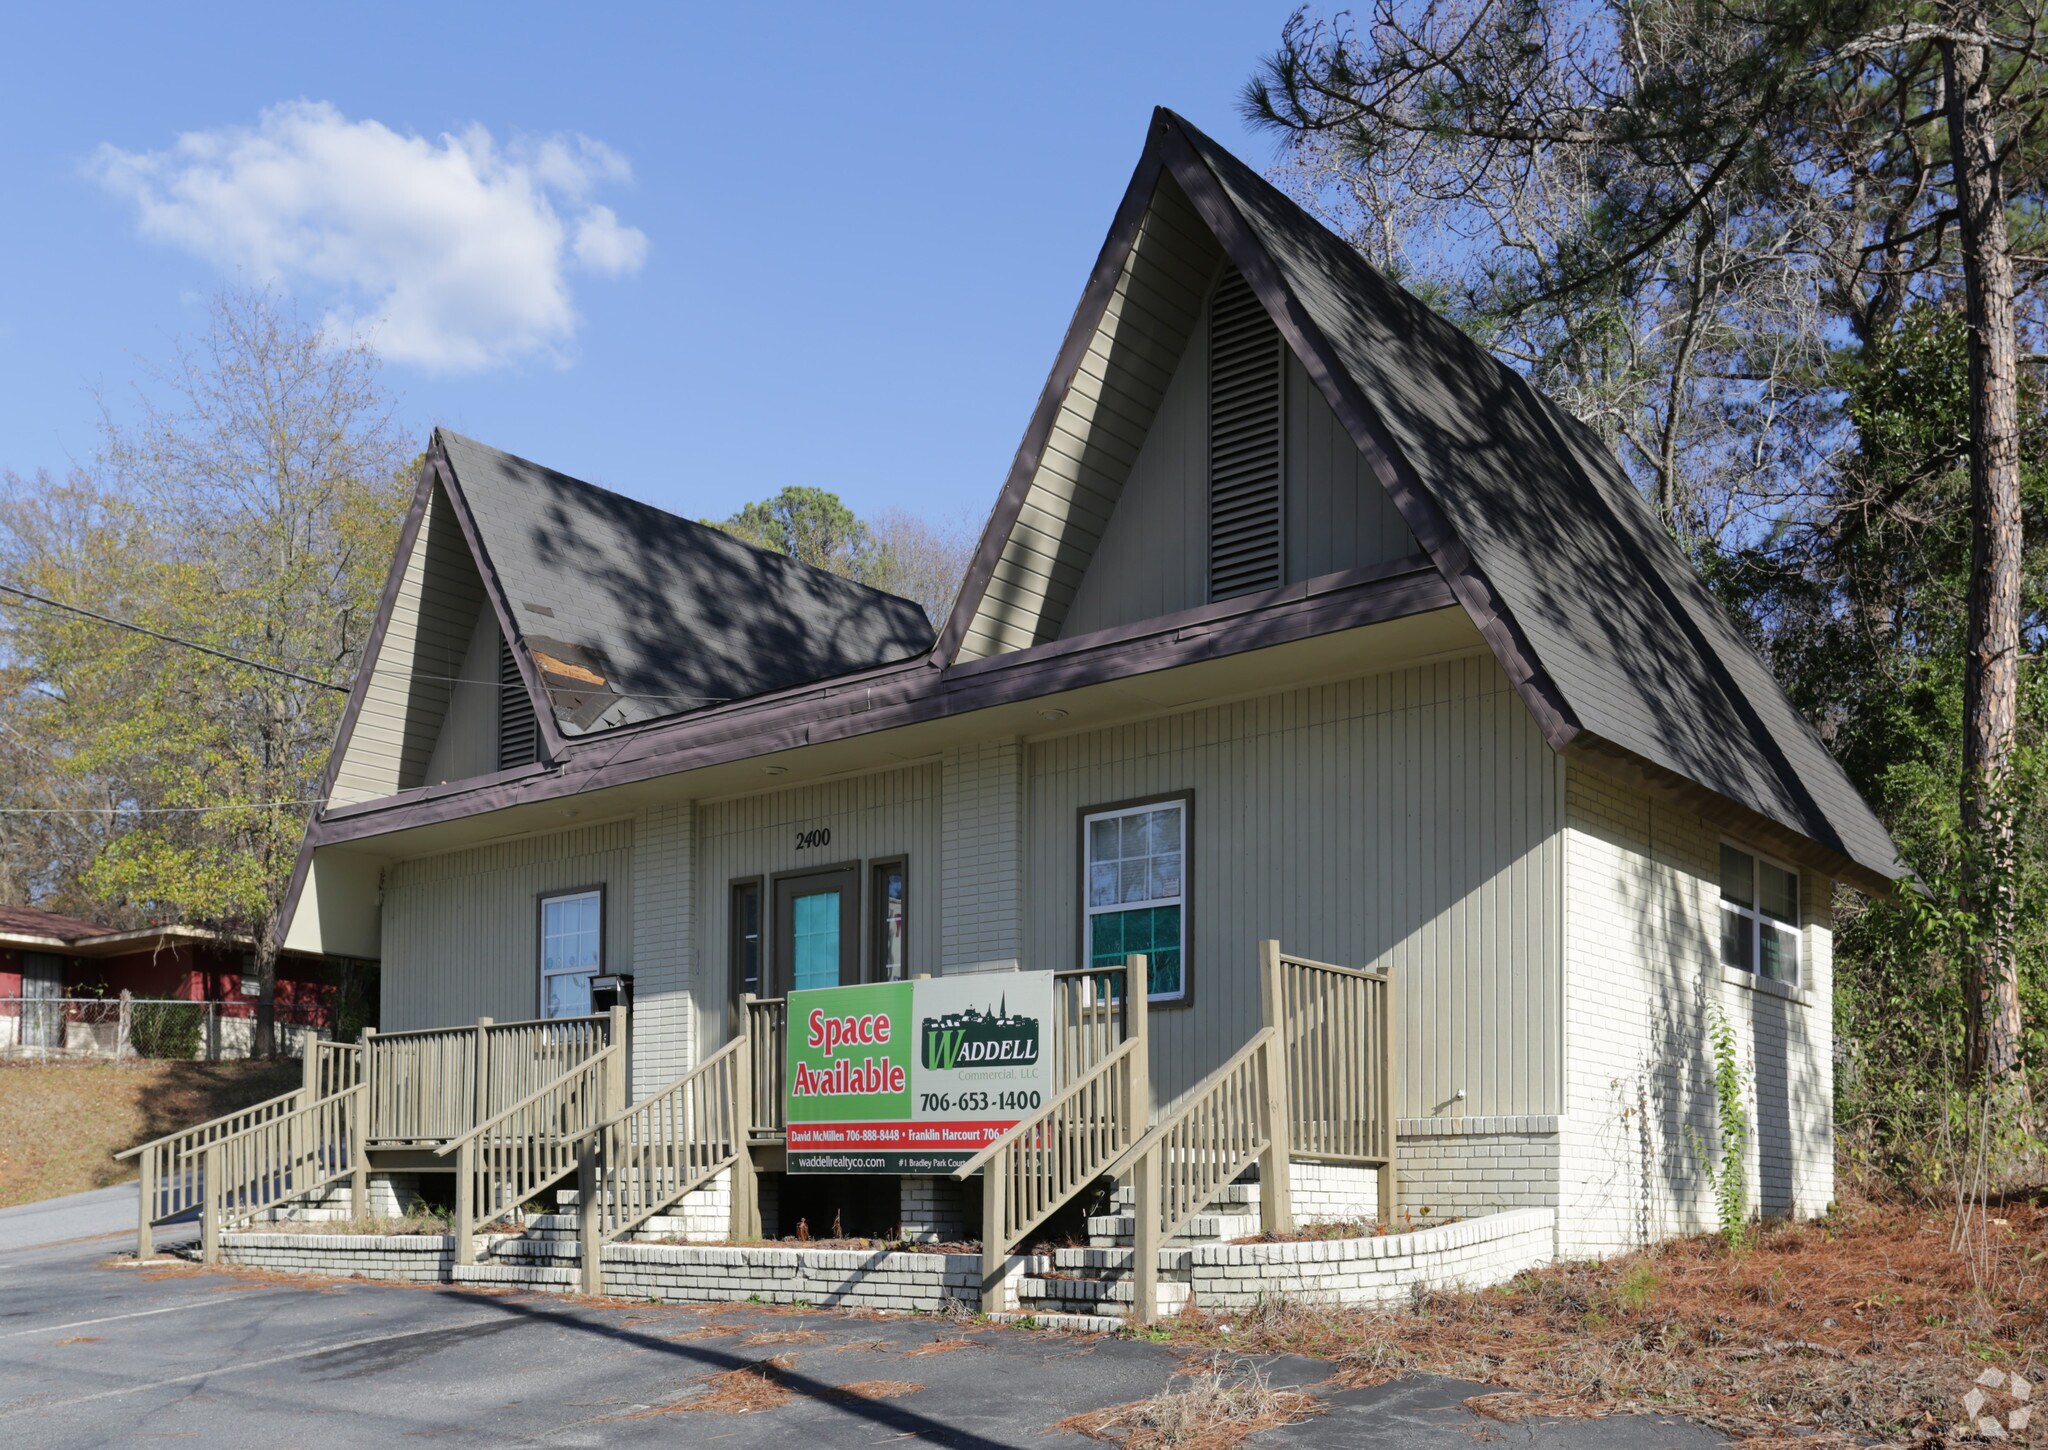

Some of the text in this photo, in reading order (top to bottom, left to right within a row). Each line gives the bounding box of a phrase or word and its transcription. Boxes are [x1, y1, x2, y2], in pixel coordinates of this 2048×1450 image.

[795, 828, 831, 850] 2400
[808, 1008, 891, 1057] Space
[927, 1029, 1038, 1071] WADDELL
[792, 1056, 906, 1097] Available
[958, 1068, 1039, 1081] Commercial, LLC
[920, 1090, 1041, 1112] 706-653-1400
[791, 1130, 811, 1142] David
[812, 1129, 844, 1141] McMillen
[846, 1129, 900, 1141] 706-888-8448
[908, 1128, 940, 1141] Franklin
[942, 1128, 980, 1141] Harcourt
[799, 1155, 885, 1170] waddellrealtyco.com
[898, 1158, 907, 1167] #1
[909, 1158, 932, 1169] Bradley
[933, 1158, 947, 1167] Park
